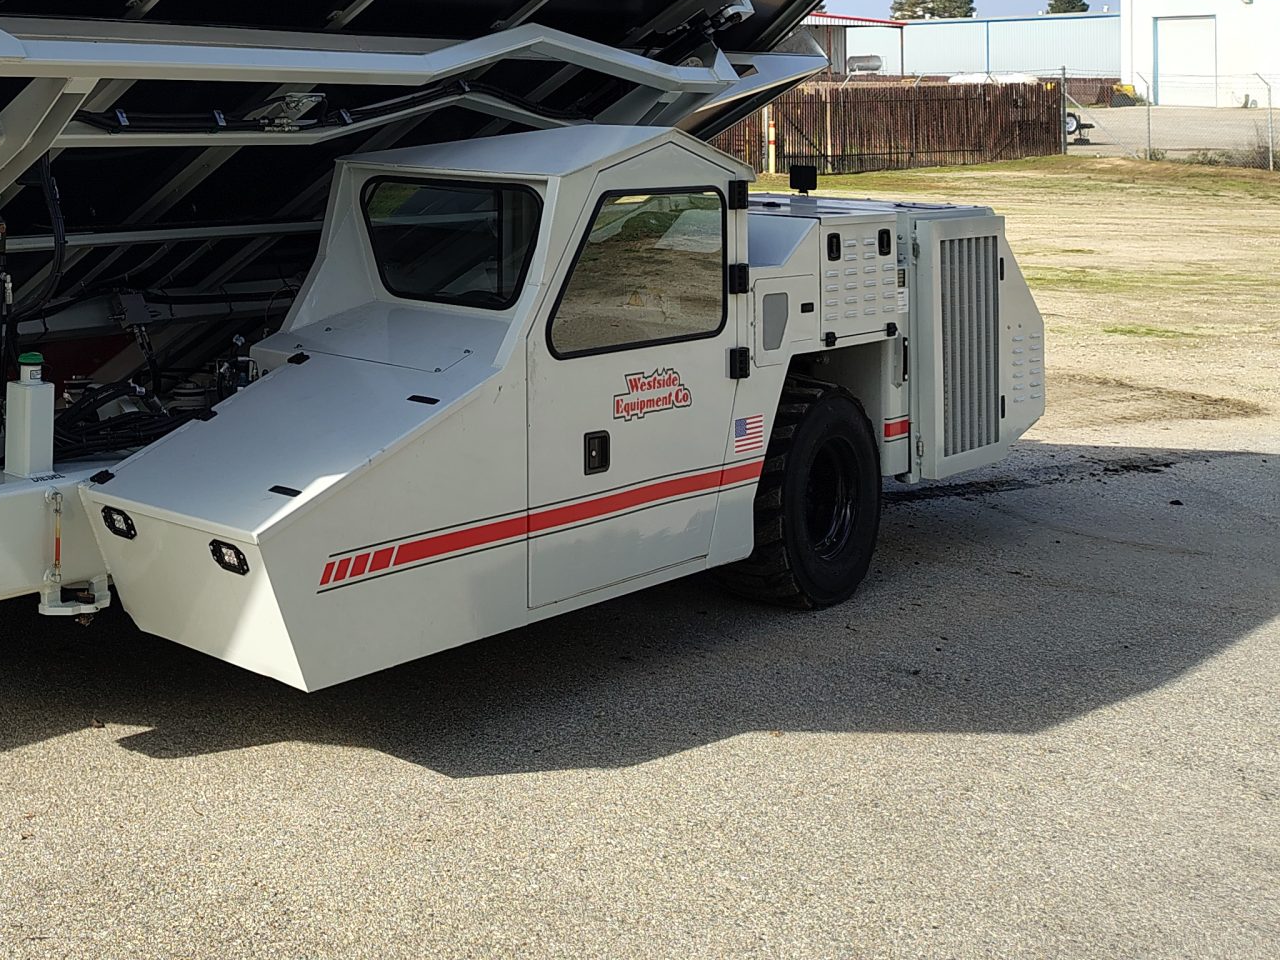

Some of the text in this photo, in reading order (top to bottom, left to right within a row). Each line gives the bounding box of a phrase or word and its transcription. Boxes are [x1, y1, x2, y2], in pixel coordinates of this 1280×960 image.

[628, 373, 678, 393] Westside
[616, 388, 689, 416] Equipment Co
